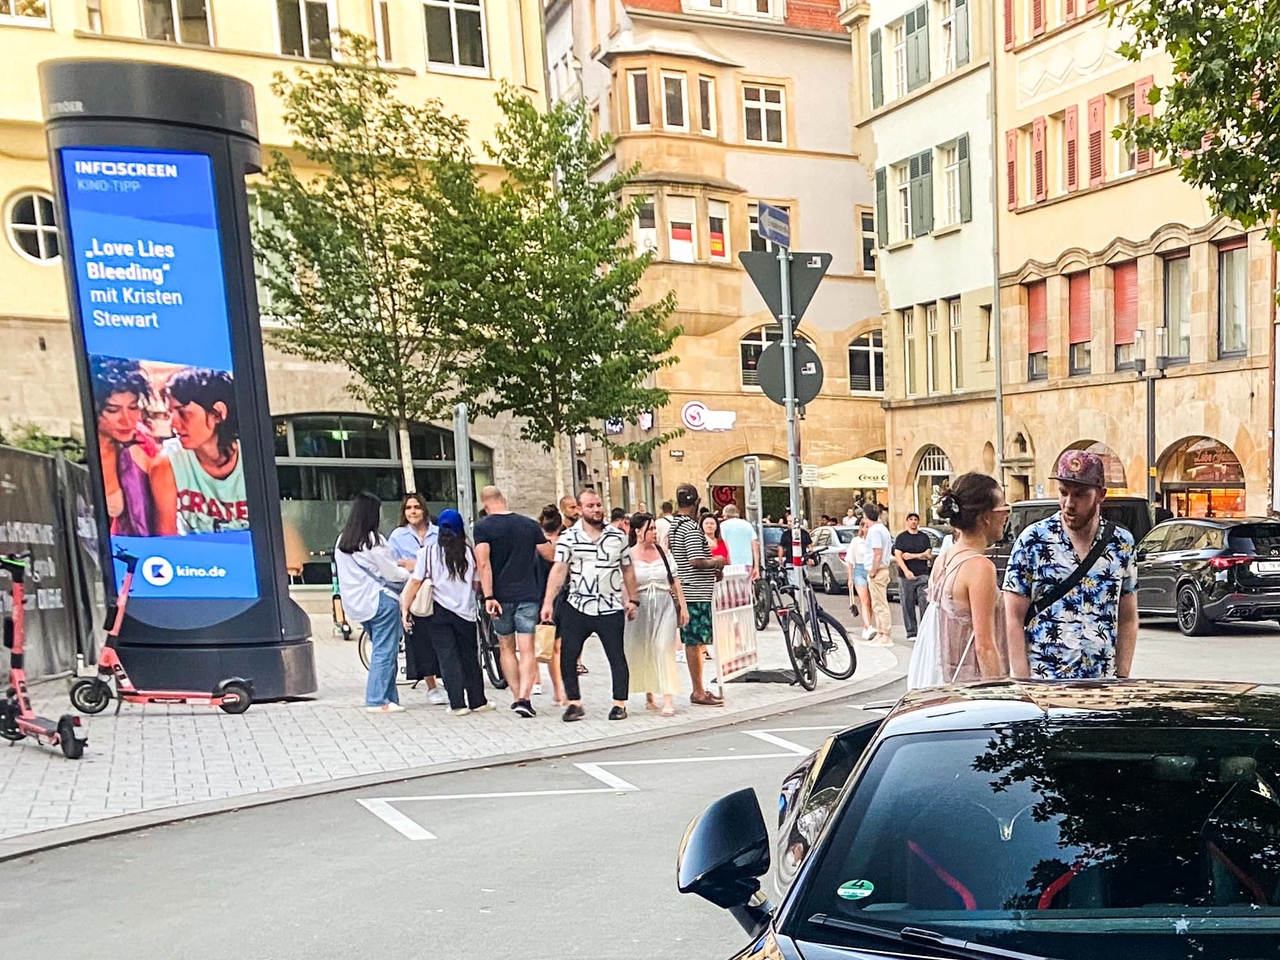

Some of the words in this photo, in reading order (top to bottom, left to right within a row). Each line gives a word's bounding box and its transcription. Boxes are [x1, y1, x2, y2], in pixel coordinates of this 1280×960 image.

[75, 160, 178, 178] INFOSCREEN
[77, 179, 140, 192] KINO-TIPP
[138, 239, 175, 258] Lies
[90, 287, 118, 303] mit
[122, 287, 183, 305] Kristen
[93, 309, 159, 328] Stewart
[176, 565, 227, 577] kino.de
